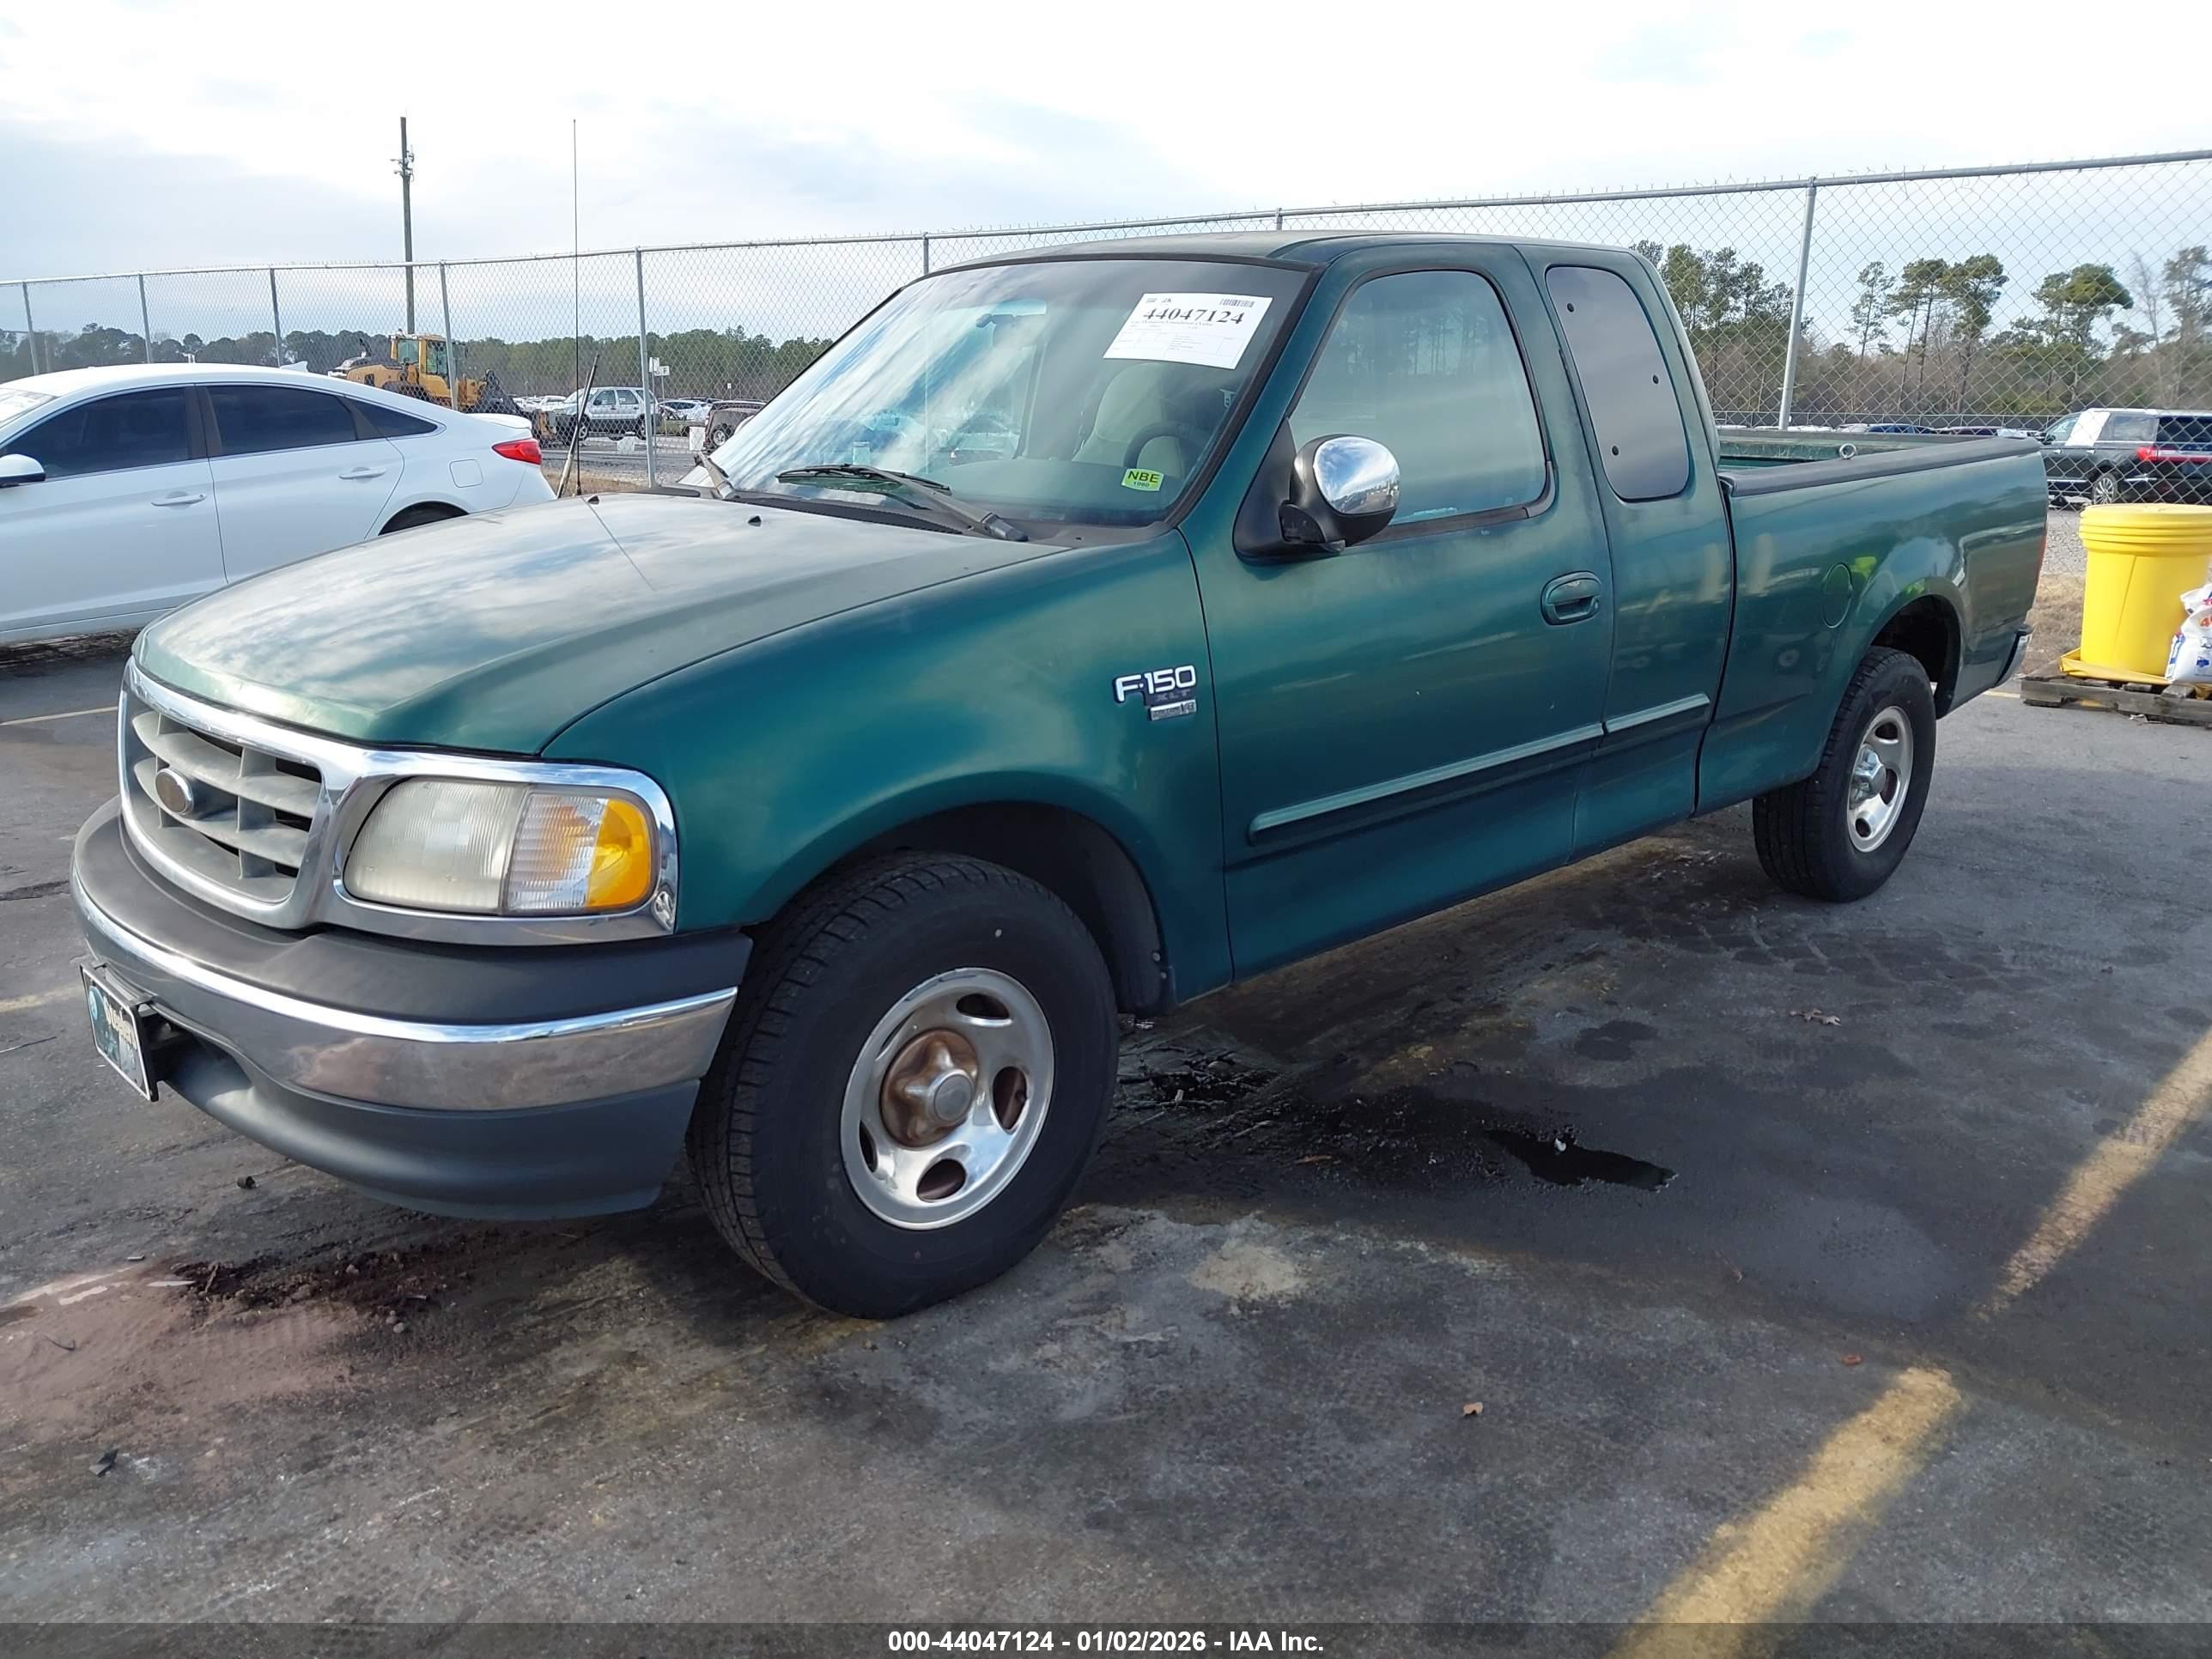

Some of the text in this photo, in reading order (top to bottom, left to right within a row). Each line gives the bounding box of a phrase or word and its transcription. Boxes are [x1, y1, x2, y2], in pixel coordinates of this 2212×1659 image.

[1143, 307, 1244, 325] 44047124
[1127, 470, 1161, 483] NBE
[1156, 690, 1191, 702] XLT
